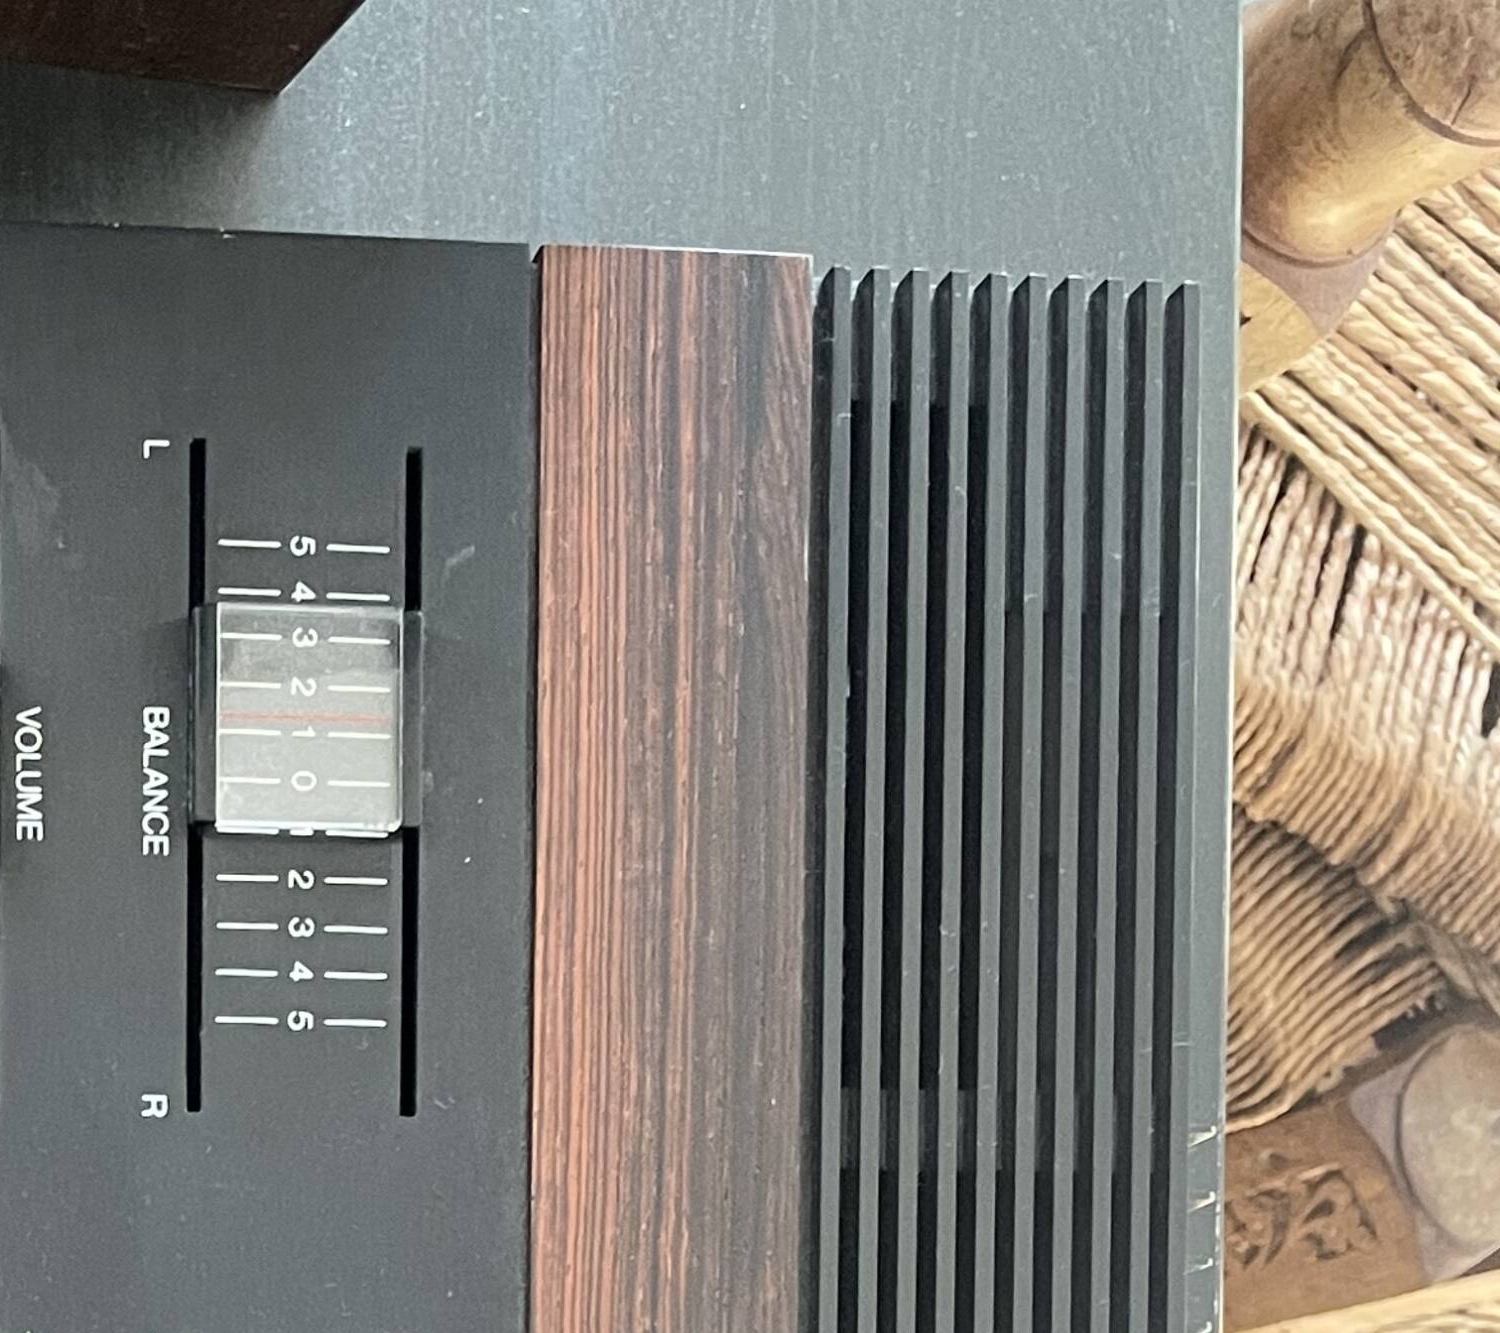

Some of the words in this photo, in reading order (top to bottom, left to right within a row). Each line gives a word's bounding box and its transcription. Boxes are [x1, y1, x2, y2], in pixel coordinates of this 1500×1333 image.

[143, 439, 170, 459] L
[289, 535, 316, 557] 5
[290, 581, 317, 603] 4
[291, 627, 319, 648] 3
[290, 676, 317, 697] 2
[291, 725, 316, 738] 1
[14, 706, 44, 842] VOLUME
[141, 706, 170, 857] BALANCE
[290, 770, 317, 792] 0
[287, 869, 315, 890] 2
[287, 917, 315, 938] 3
[289, 960, 314, 982] 4
[287, 1010, 314, 1031] 5
[141, 1094, 168, 1118] R
